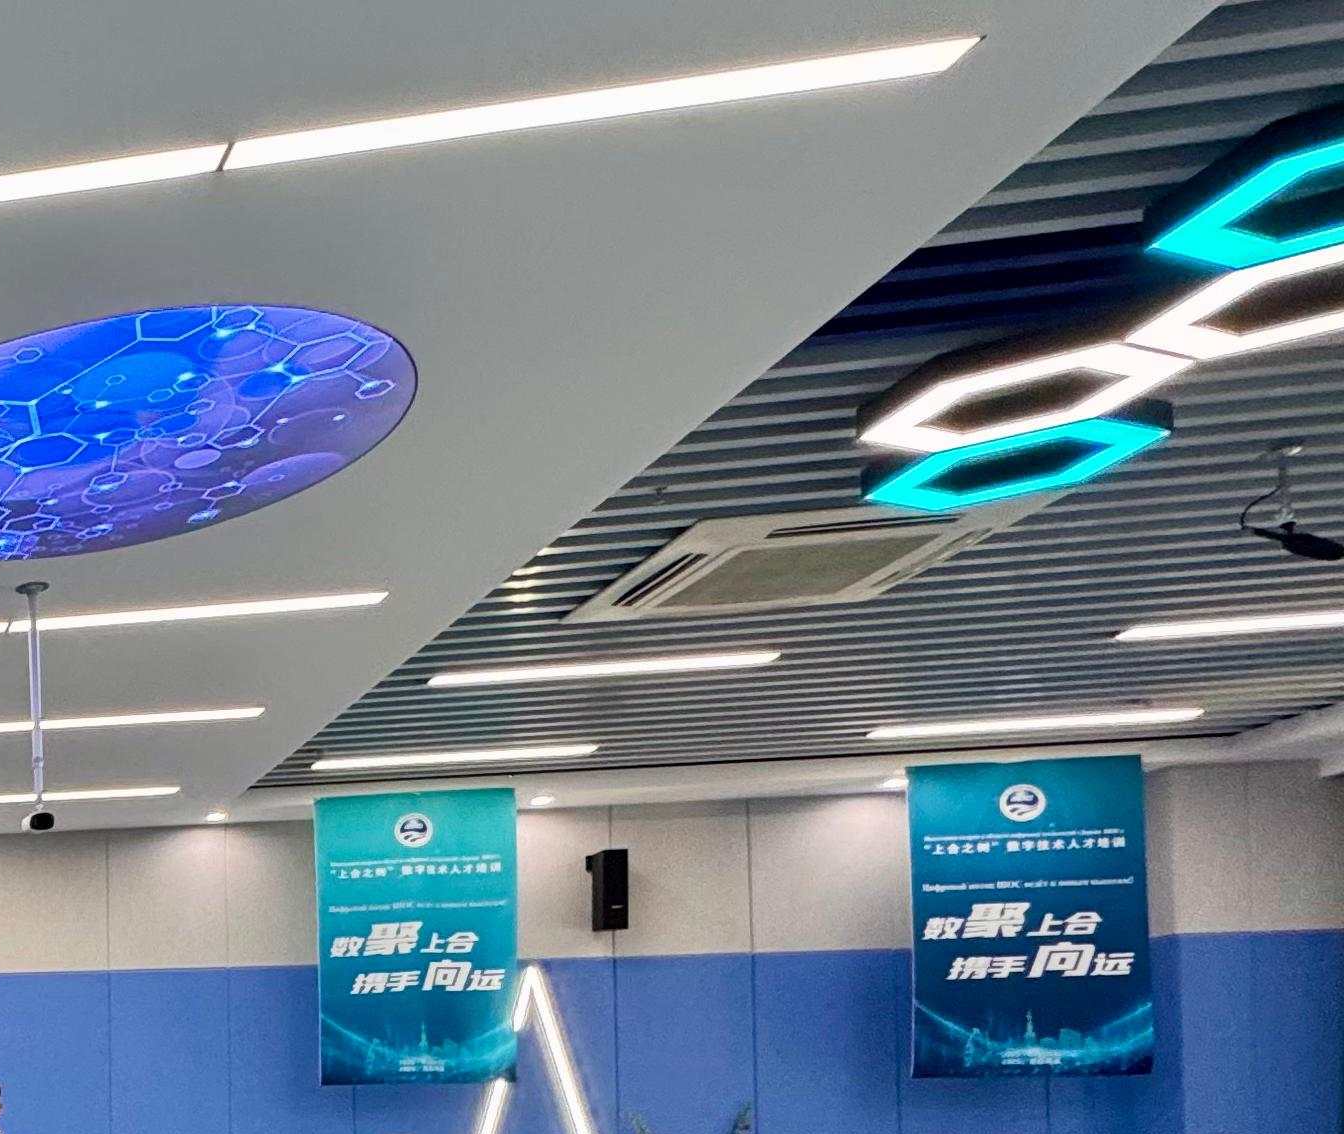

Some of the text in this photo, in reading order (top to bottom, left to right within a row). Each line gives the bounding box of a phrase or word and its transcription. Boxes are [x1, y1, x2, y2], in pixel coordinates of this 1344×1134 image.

[329, 920, 480, 958] 数聚上合
[921, 901, 1104, 941] 数聚上合
[349, 958, 506, 996] 携手向远
[945, 941, 1135, 981] 携手向远
